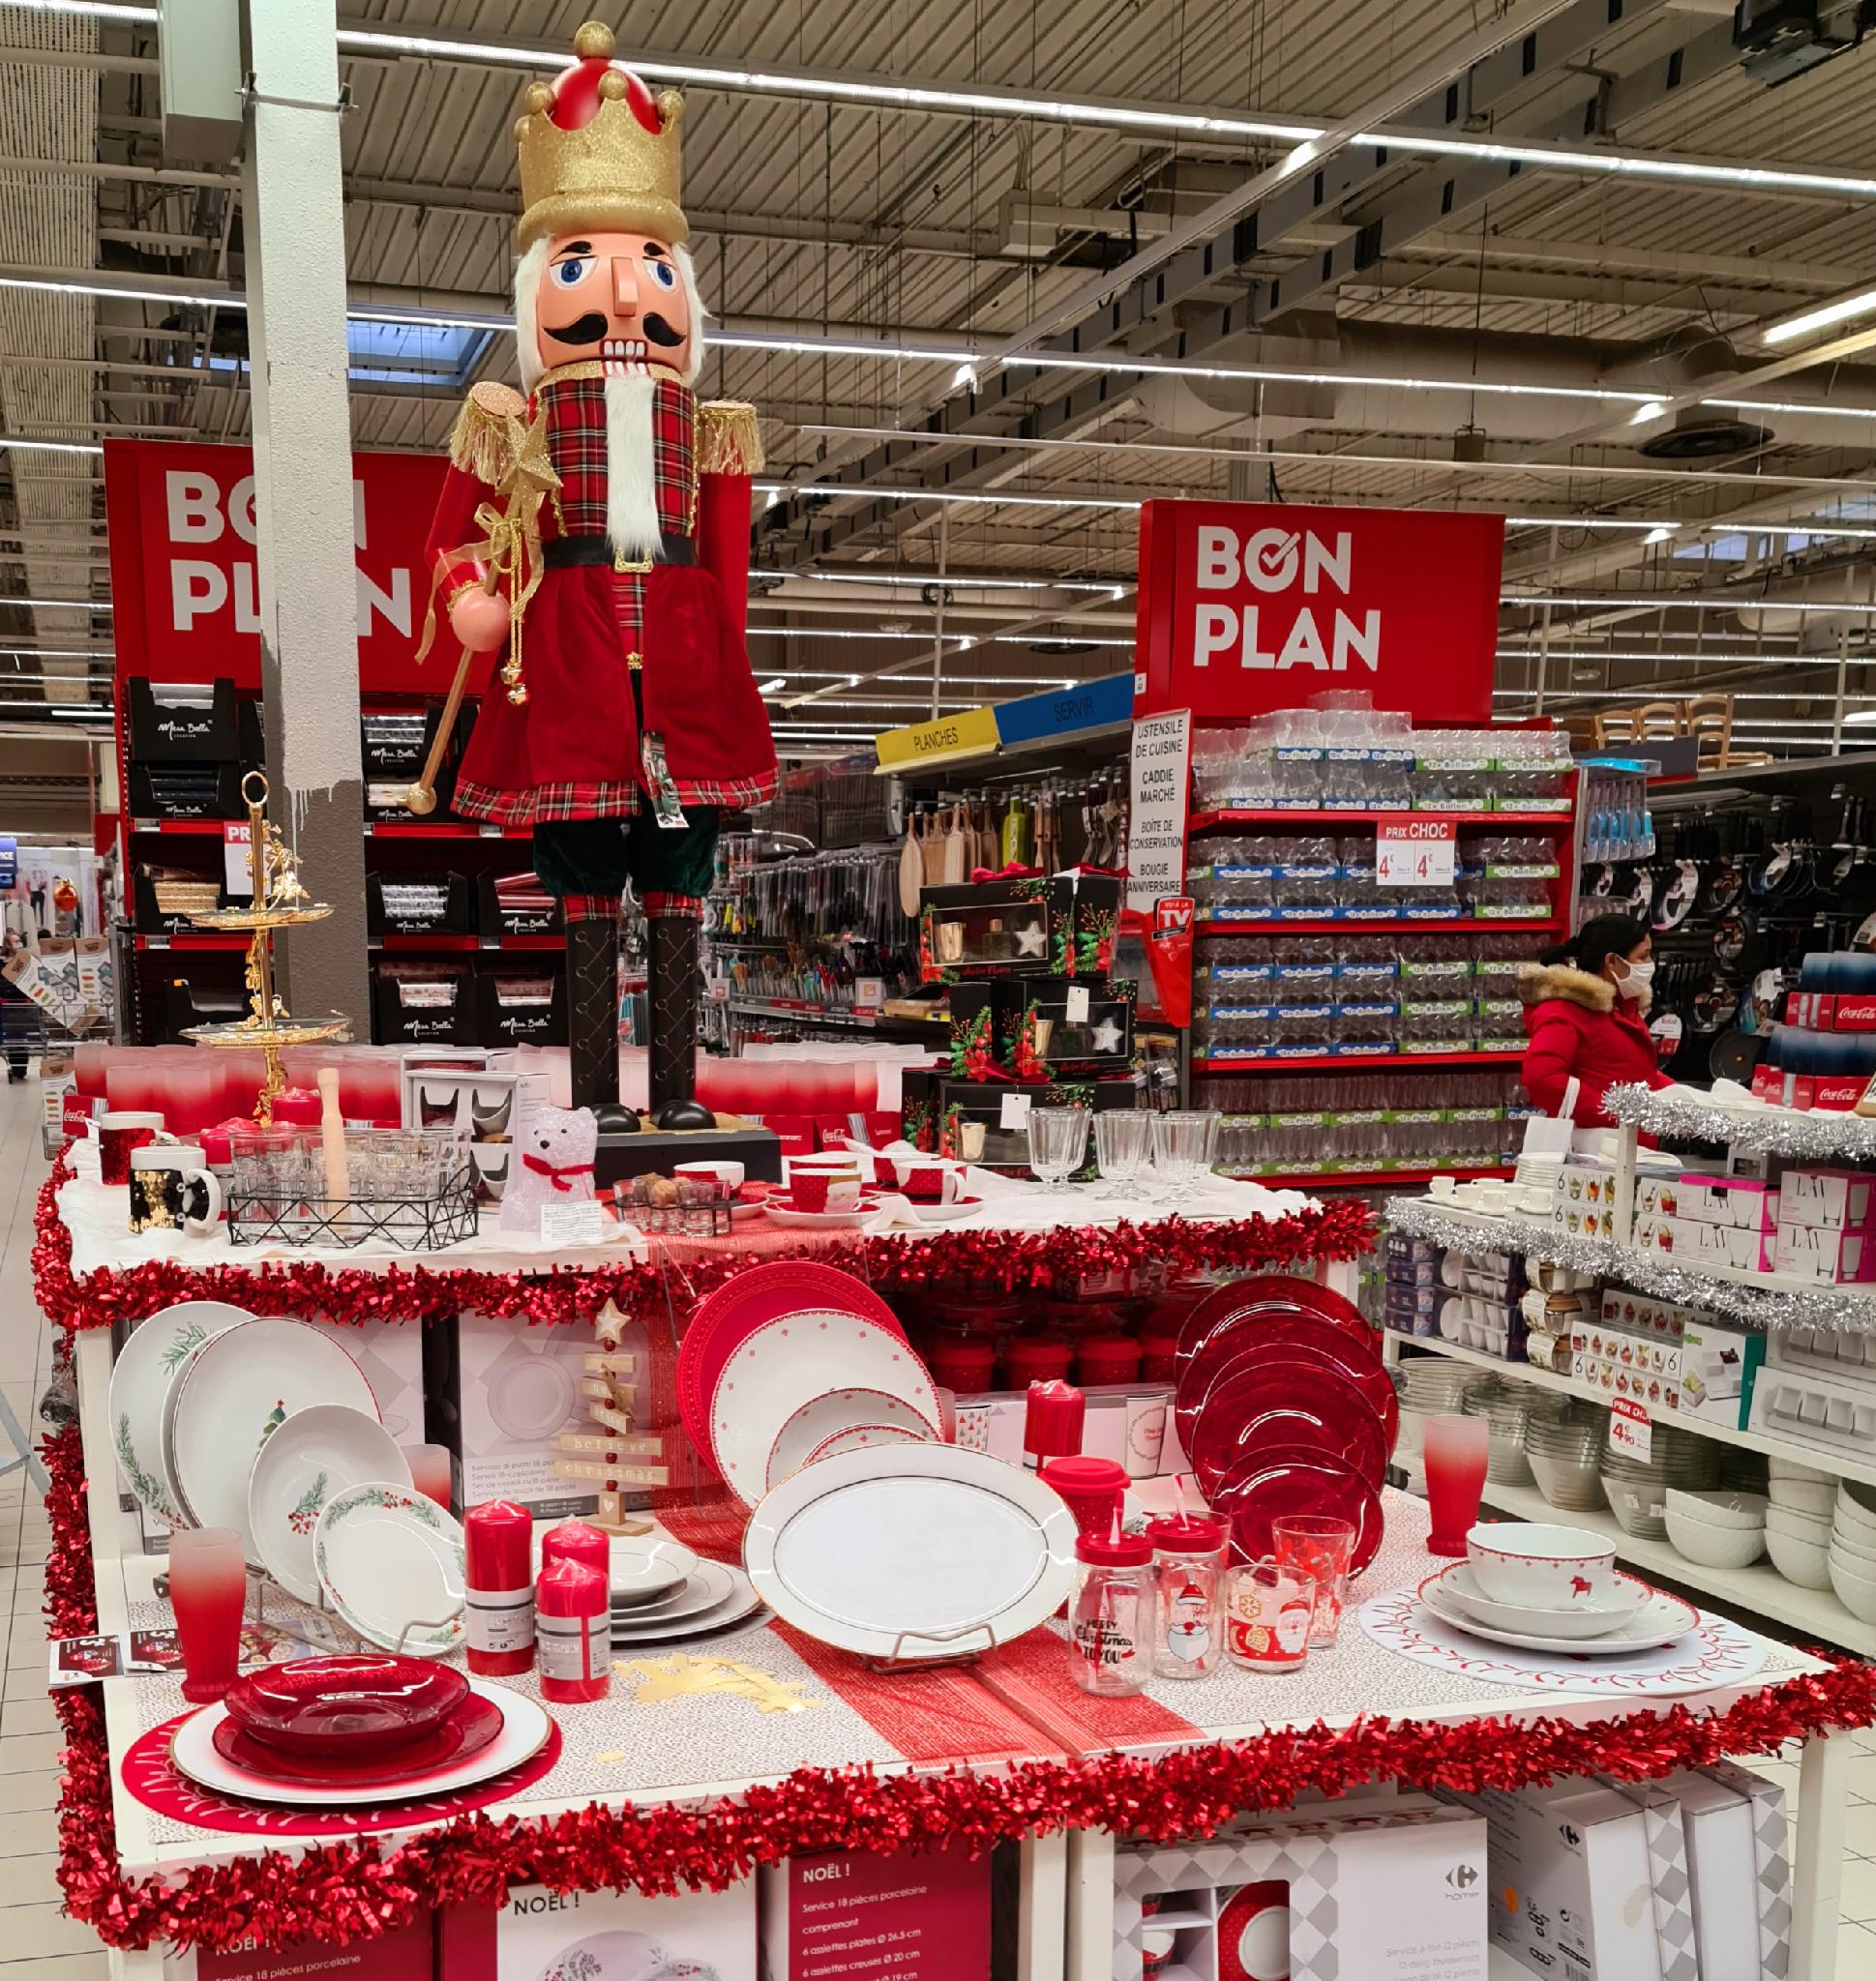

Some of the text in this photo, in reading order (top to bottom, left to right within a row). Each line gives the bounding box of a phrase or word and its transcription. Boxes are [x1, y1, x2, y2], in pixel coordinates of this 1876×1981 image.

[1196, 525, 1353, 595] BON
[170, 559, 412, 638] PLN
[1193, 604, 1382, 672] PLAN
[1053, 695, 1095, 723] SERVIR
[913, 726, 959, 752] PLANCHES
[1138, 719, 1183, 739] USTENSILE
[1135, 739, 1183, 758] DE CUISINE
[1142, 768, 1174, 784] CADDIE
[1140, 784, 1176, 804] MARCHÉ
[1163, 819, 1173, 832] DE
[1385, 822, 1448, 839] PRIX CHOC
[1129, 834, 1183, 850] CONSERVATION
[1140, 863, 1169, 876] BOUGIE
[1127, 880, 1180, 893] ANNIVERSAIRE
[1160, 909, 1191, 929] TV
[1557, 1170, 1565, 1191] 6
[1554, 1204, 1563, 1223] 6
[1575, 1355, 1583, 1374] 6
[1668, 1351, 1677, 1371] 6
[1614, 1400, 1631, 1412] PRIX
[574, 1438, 646, 1452] believe
[564, 1463, 654, 1482] christmas
[1086, 1619, 1118, 1630] MERRY
[1075, 1624, 1133, 1646] Christmas
[1097, 1649, 1120, 1665] YOU
[803, 1863, 850, 1883] NOËL !
[514, 1890, 581, 1916] NOËL !
[802, 1885, 928, 1913] Service 18 pièces porcelaine
[802, 1917, 859, 1935] comprenant
[802, 1947, 809, 1956] 6
[810, 1942, 848, 1955] assiettes
[849, 1937, 877, 1950] plates
[907, 1929, 922, 1938] cm
[256, 1955, 362, 1981] 18 pièces porcelaine
[802, 1968, 809, 1978] 6
[810, 1964, 848, 1976] assiettes
[849, 1957, 881, 1969] creuses
[893, 1952, 905, 1963] 20
[905, 1950, 921, 1960] cm
[903, 1971, 918, 1981] cm
